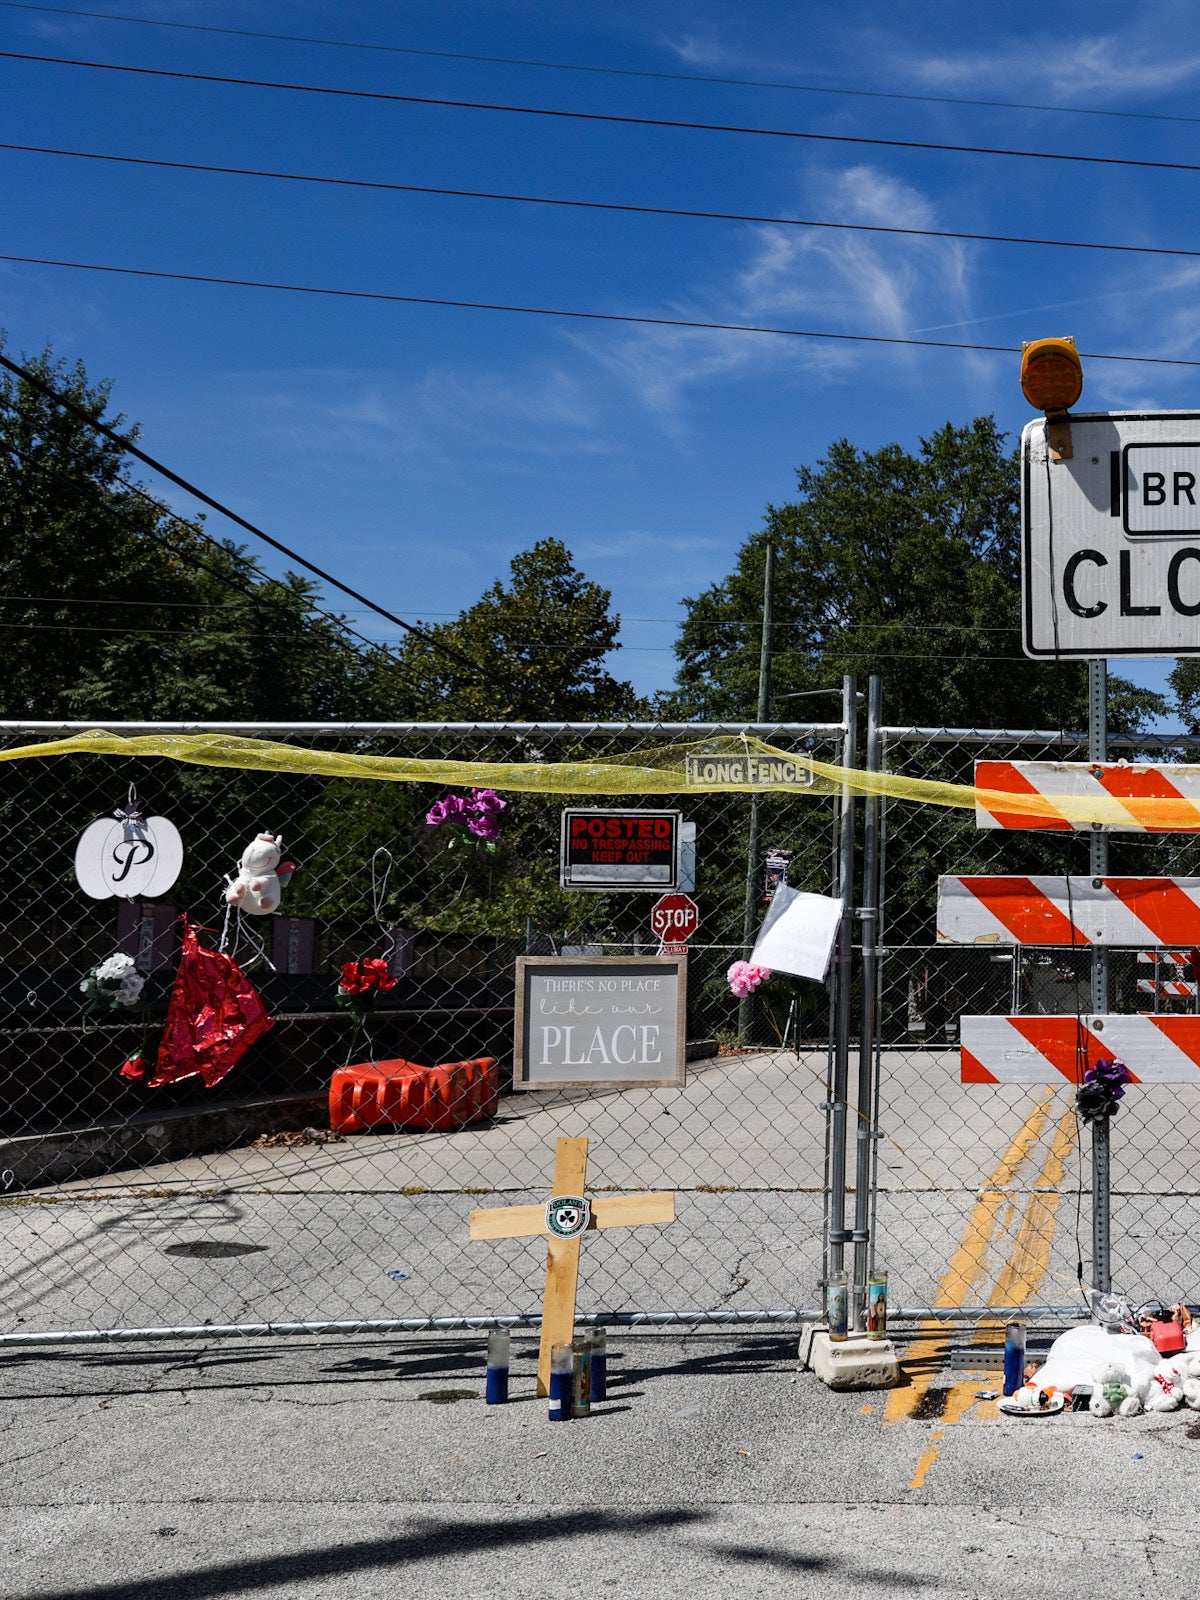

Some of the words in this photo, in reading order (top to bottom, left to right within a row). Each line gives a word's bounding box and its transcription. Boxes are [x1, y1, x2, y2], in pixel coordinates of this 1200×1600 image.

[693, 759, 743, 783] LONG
[747, 757, 806, 784] FENCE
[571, 818, 671, 838] POSTED
[572, 838, 588, 850] NO
[592, 839, 671, 851] TRESPASSING
[112, 839, 154, 882] P
[592, 851, 622, 863] KEEP
[625, 852, 649, 863] OUT
[654, 908, 695, 928] STOP
[543, 979, 594, 992] THERE'S
[598, 979, 616, 992] NO
[621, 979, 662, 992] PLACE
[539, 997, 604, 1016] like
[611, 1002, 663, 1014] our
[538, 1025, 662, 1065] PLACE
[553, 1199, 582, 1208] DOLAN'S
